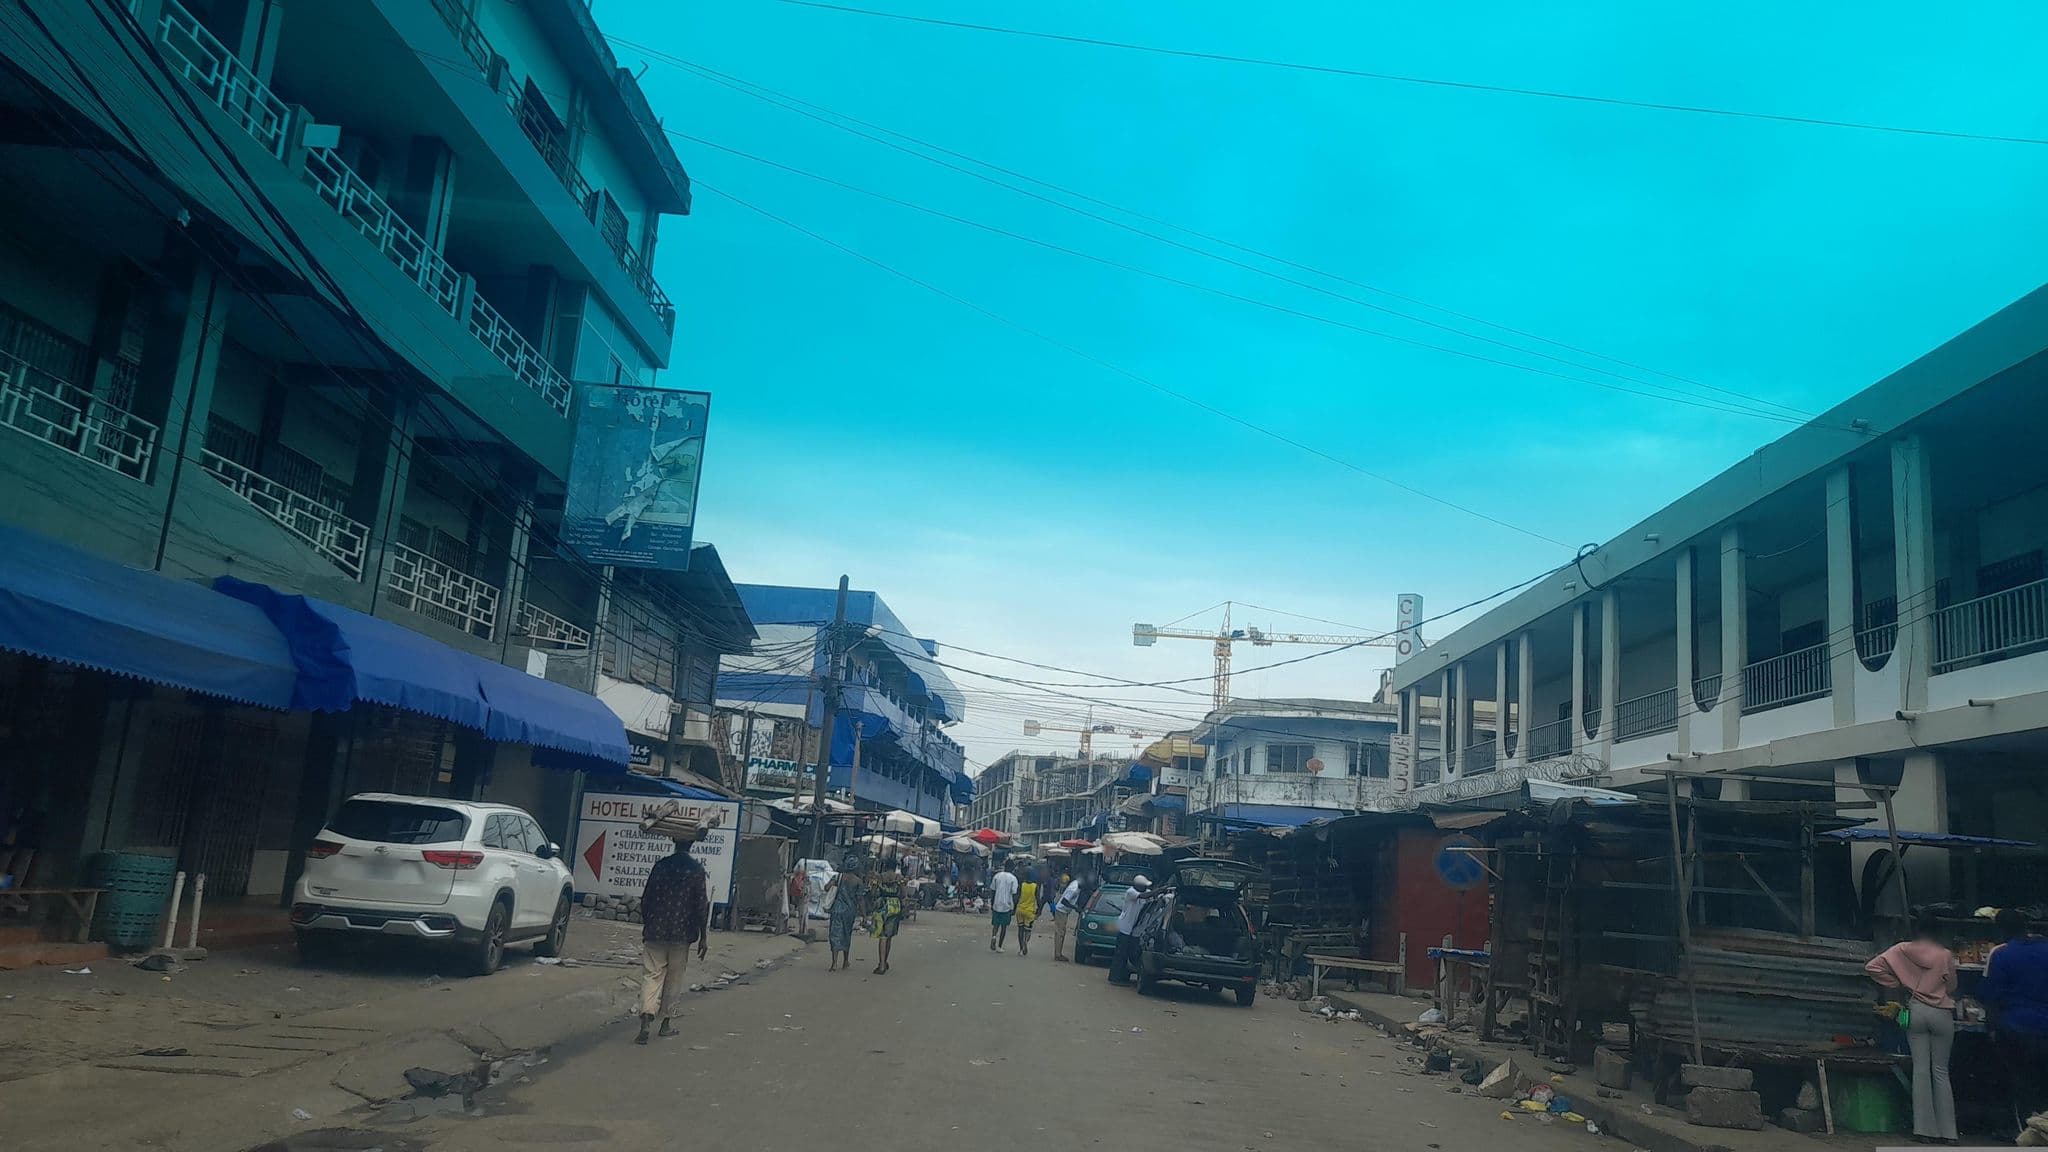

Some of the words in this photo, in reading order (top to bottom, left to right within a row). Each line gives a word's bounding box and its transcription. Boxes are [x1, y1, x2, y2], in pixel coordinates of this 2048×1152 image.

[749, 757, 816, 774] PHARMCI
[591, 800, 637, 817] HOTEL
[641, 803, 729, 824] MANIFIT
[620, 829, 666, 841] CHAMBRES
[618, 841, 646, 850] SUITE
[647, 843, 672, 852] HAUT
[689, 844, 722, 855] GAMME
[616, 852, 660, 863] RESTAUR
[614, 865, 650, 875] SALLES
[613, 877, 648, 887] SERVIC
